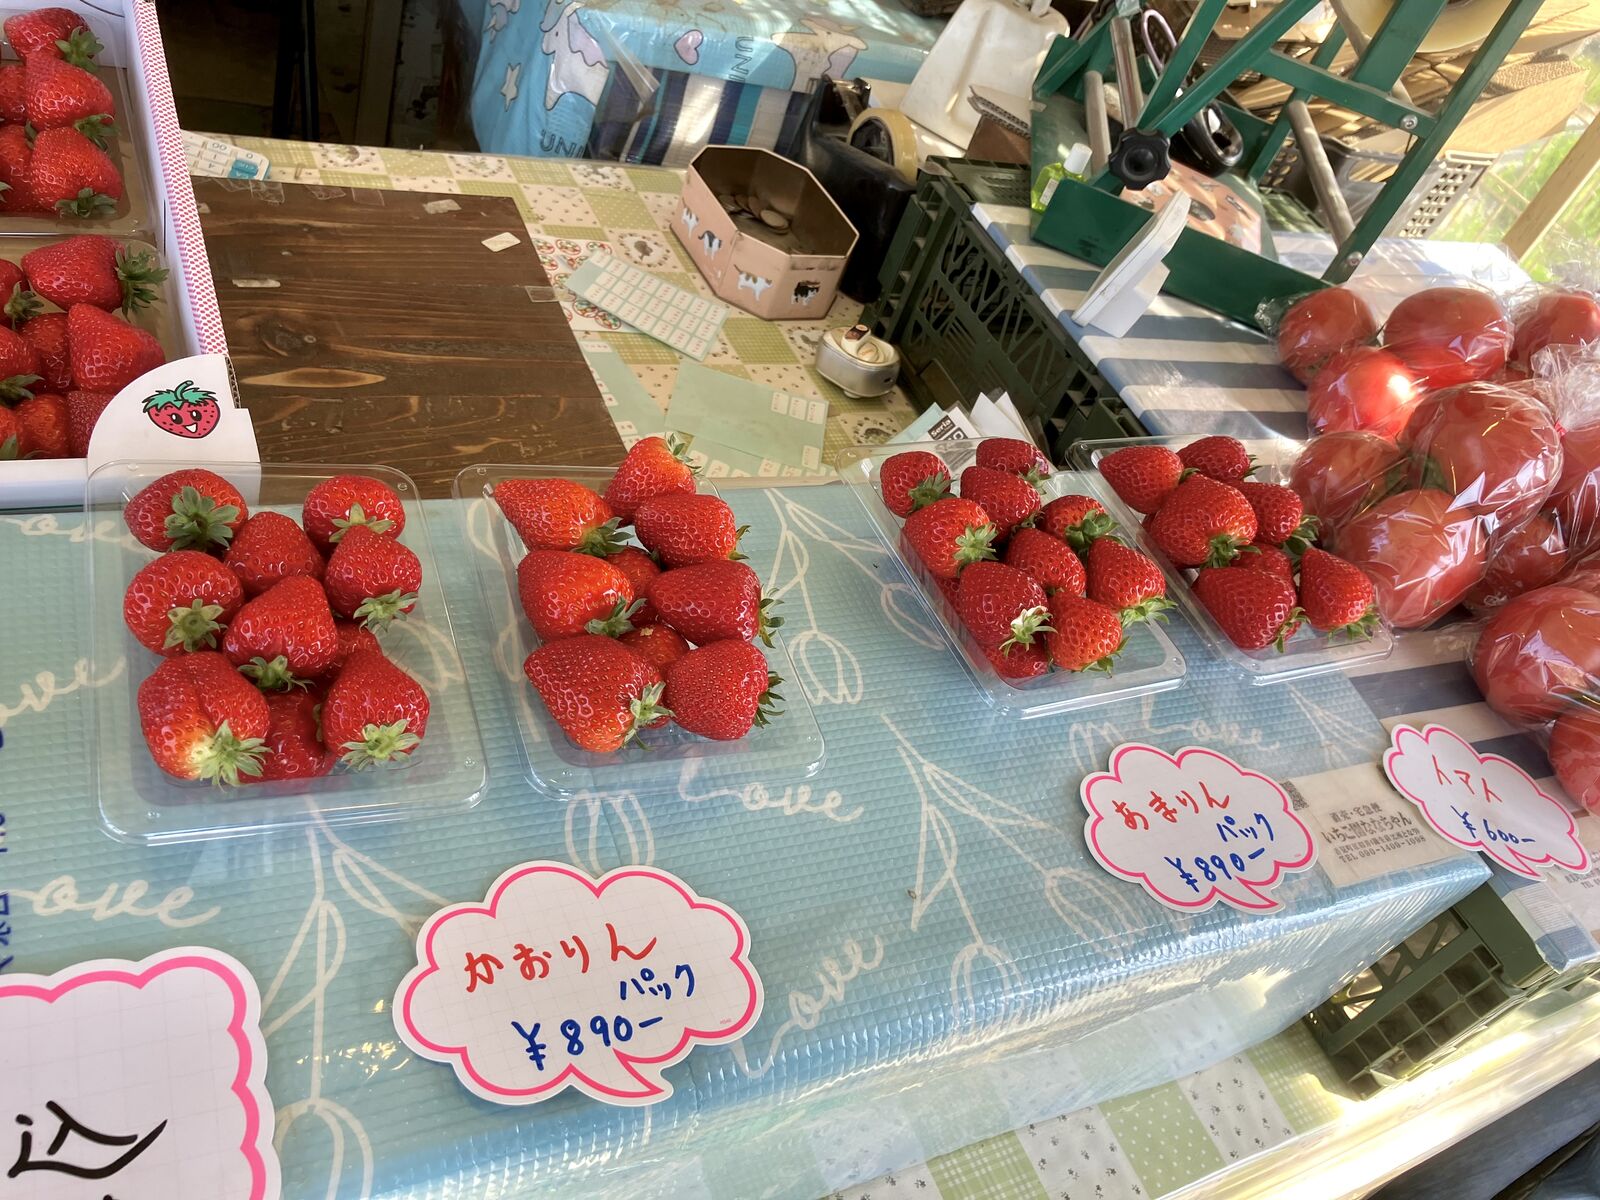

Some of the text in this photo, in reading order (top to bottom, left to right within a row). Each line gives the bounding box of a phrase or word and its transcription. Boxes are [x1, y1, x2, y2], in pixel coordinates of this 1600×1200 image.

[930, 419, 952, 438] Seria
[1432, 754, 1503, 803] トマト
[1112, 781, 1230, 831] あまりん
[1216, 813, 1275, 843] パック
[1339, 854, 1359, 863] TEL
[464, 922, 657, 993] かおりん
[619, 964, 696, 1001] パック
